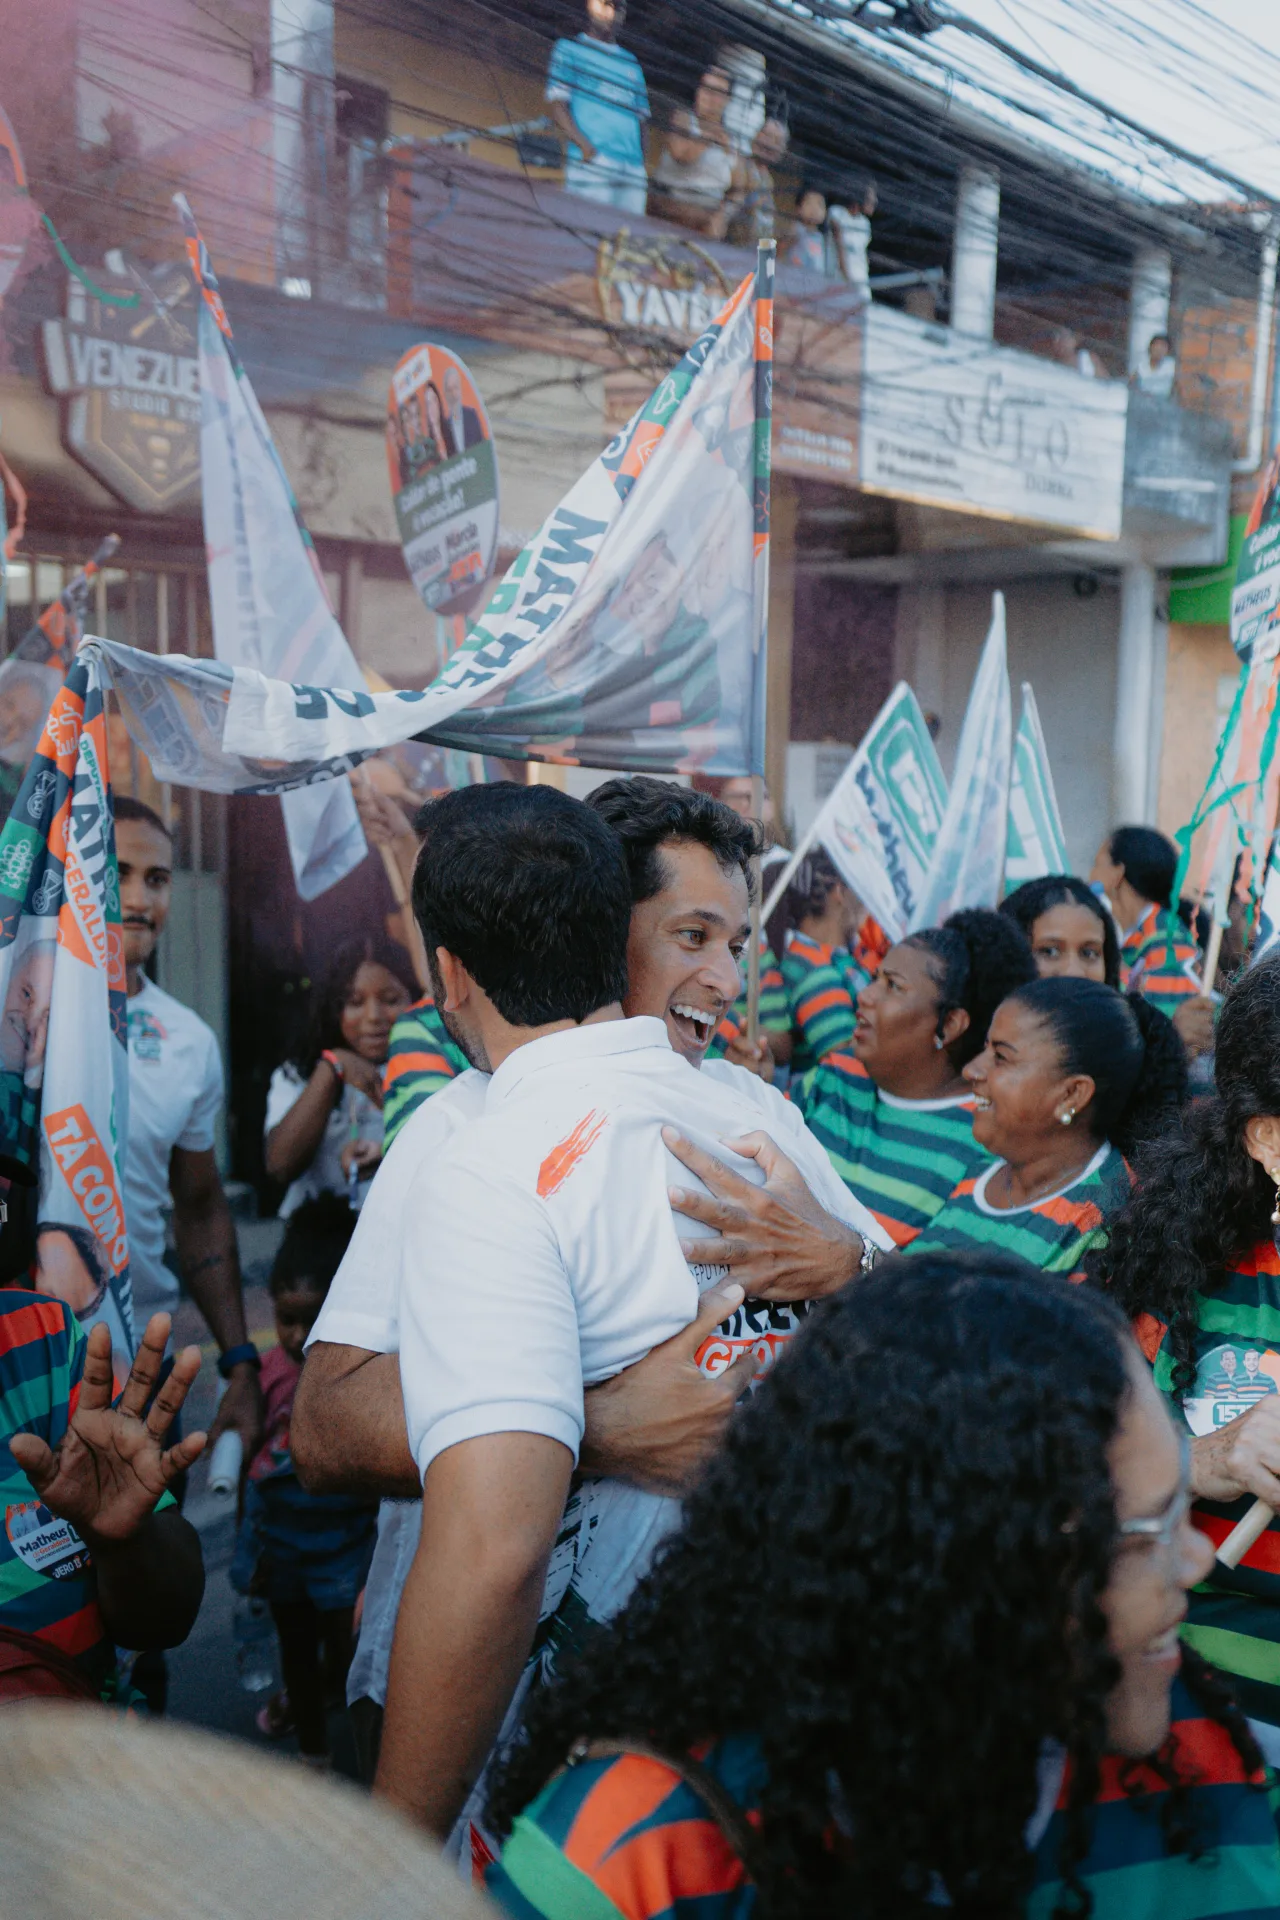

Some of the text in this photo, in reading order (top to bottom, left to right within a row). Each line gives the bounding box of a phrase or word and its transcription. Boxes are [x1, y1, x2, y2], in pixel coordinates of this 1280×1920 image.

[50, 1116, 129, 1266] TÁ COMO
[19, 1527, 68, 1556] Matheus
